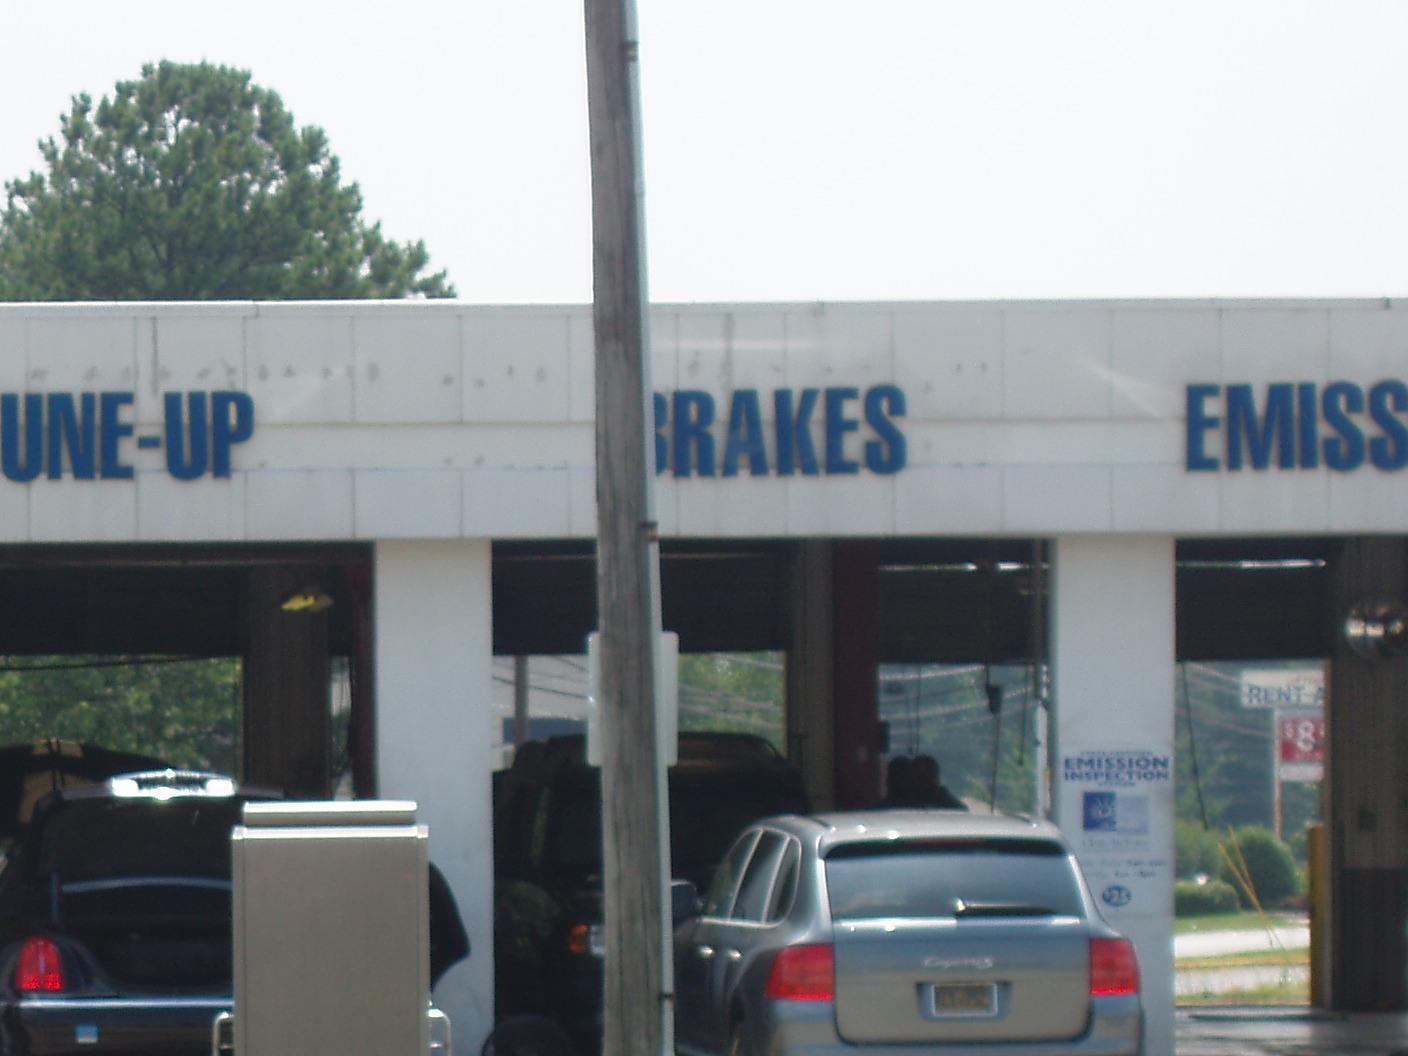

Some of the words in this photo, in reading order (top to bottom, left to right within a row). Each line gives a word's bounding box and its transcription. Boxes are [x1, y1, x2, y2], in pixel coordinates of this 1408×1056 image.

[1185, 379, 1408, 472] EMISS
[1064, 757, 1169, 770] EMISSION
[1064, 771, 1169, 781] INSPECTION
